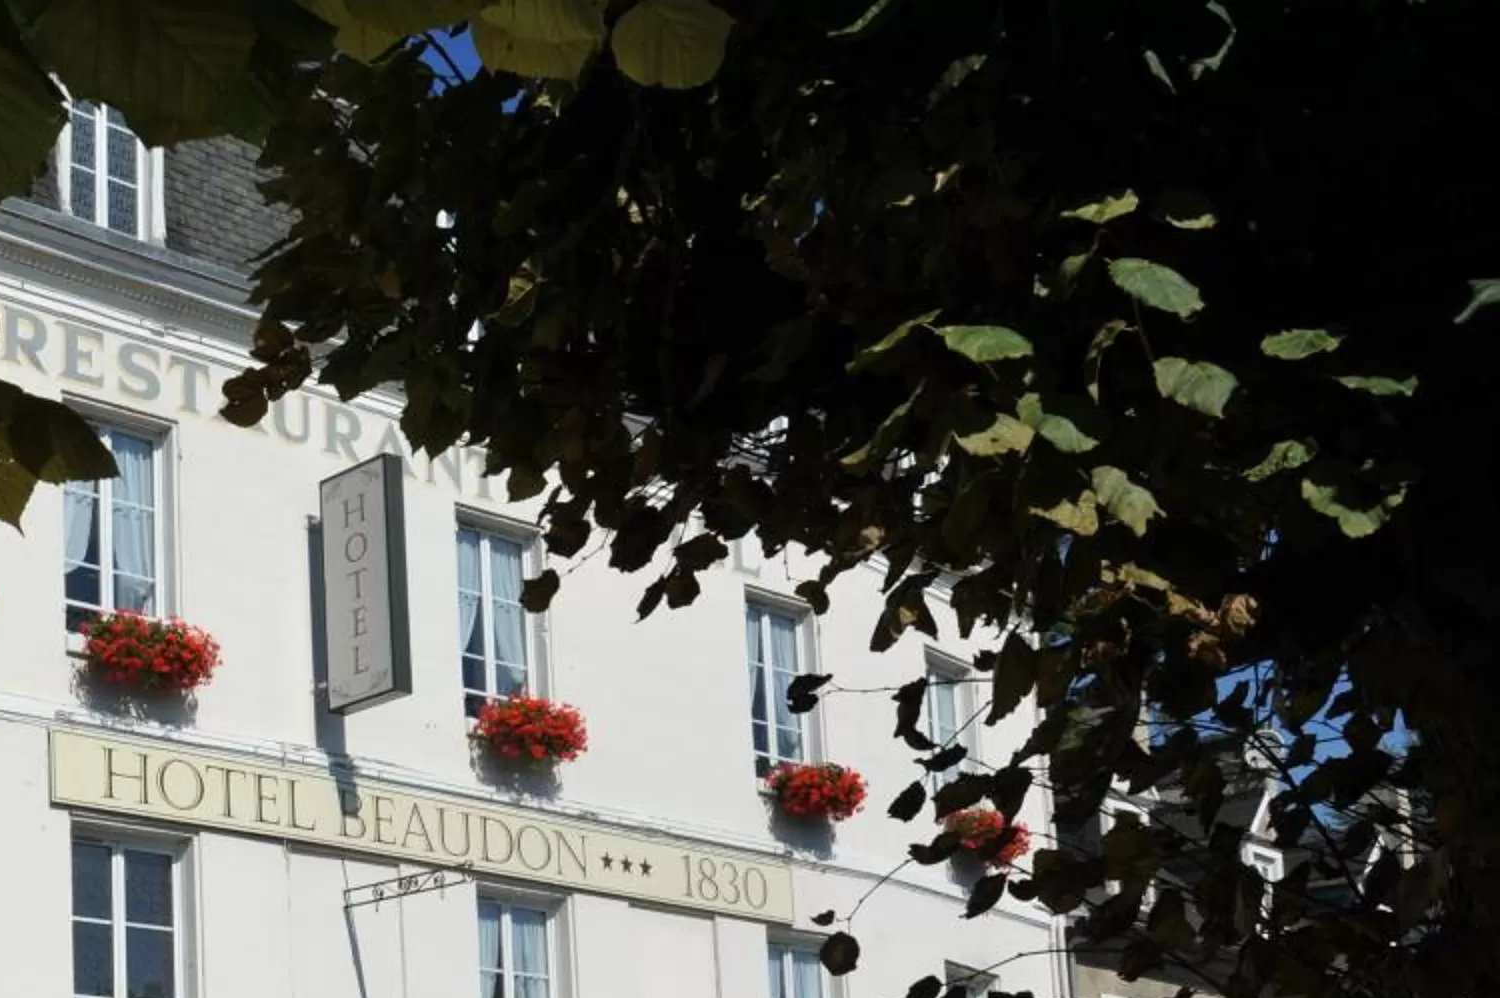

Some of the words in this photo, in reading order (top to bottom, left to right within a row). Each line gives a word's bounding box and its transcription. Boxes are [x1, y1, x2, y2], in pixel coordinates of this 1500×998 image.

[0, 304, 494, 498] RESTURANT
[341, 492, 370, 676] HOTEL
[102, 746, 317, 832] HOTEL
[338, 788, 590, 879] BEAUDON
[680, 854, 769, 911] 1830
